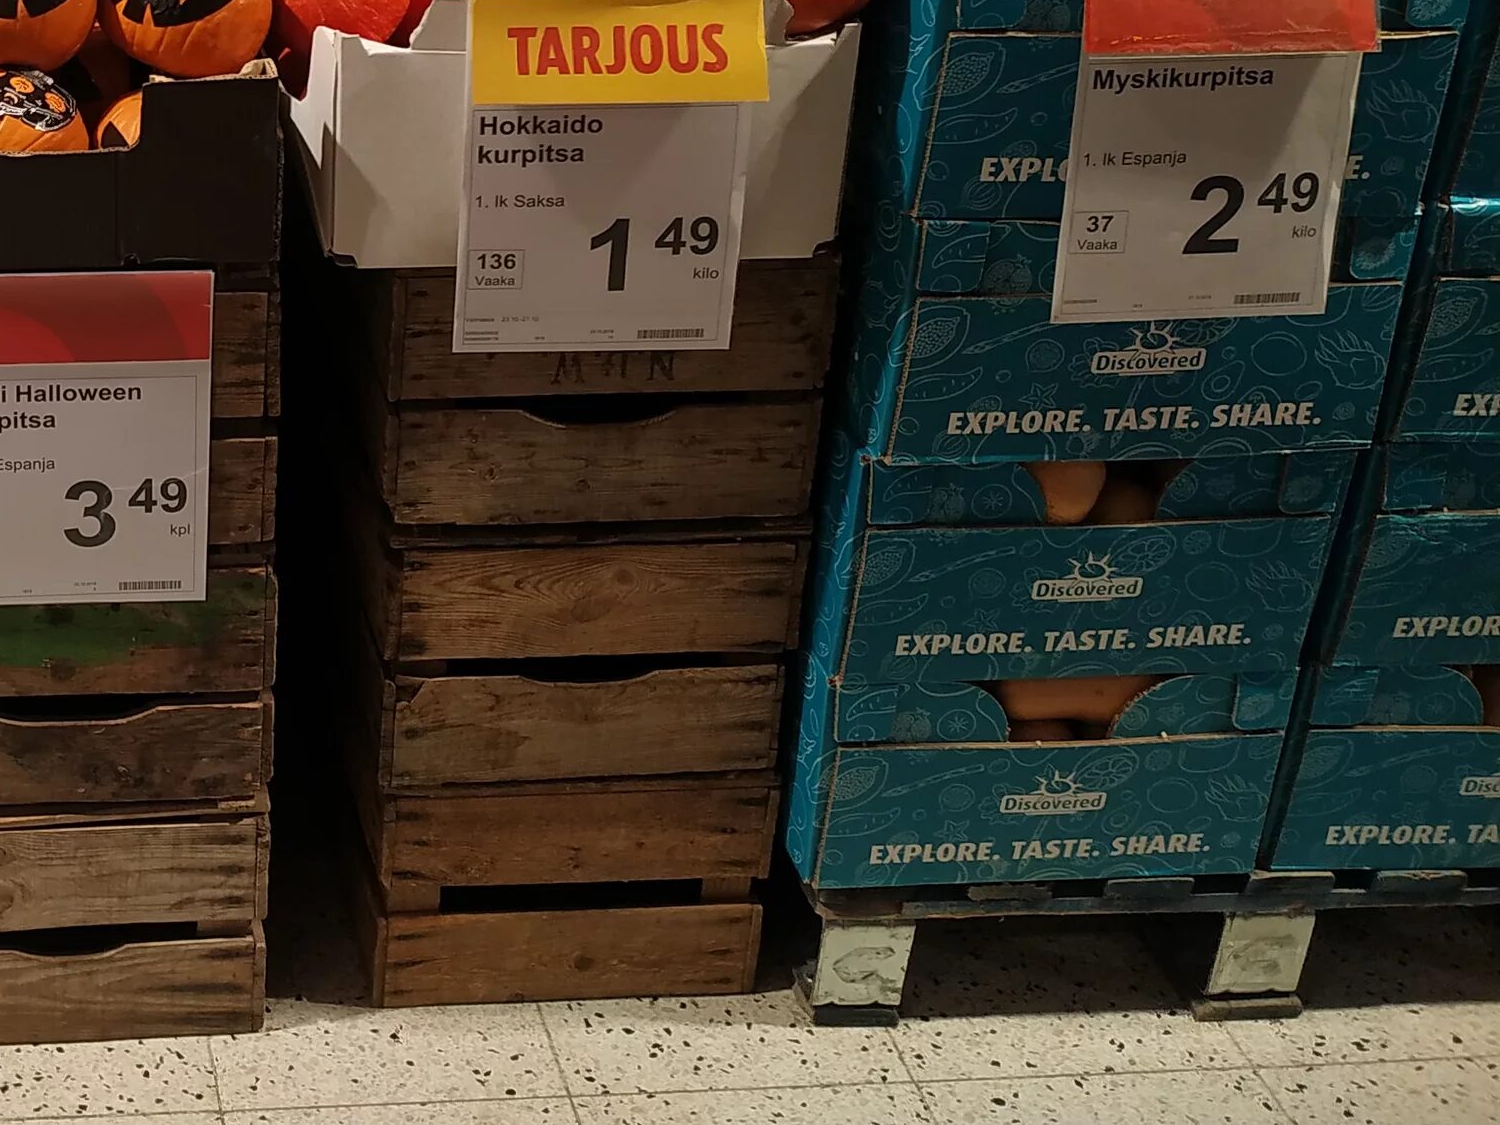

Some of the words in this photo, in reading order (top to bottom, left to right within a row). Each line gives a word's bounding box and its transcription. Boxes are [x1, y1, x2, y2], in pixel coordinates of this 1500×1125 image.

[507, 23, 729, 76] TARJOUS
[1092, 66, 1275, 95] Myskikurpitsa
[478, 115, 604, 136] Hokkaido
[477, 145, 585, 168] kurpitsa
[1083, 153, 1097, 167] 1.
[1122, 151, 1187, 170] Espanja
[475, 195, 489, 209] 1.
[514, 194, 566, 208] Saksa
[1086, 215, 1115, 233] 37
[1181, 175, 1245, 255] 2
[1257, 172, 1321, 214] 49
[1292, 225, 1317, 239] kilo
[589, 217, 631, 292] 1
[654, 216, 720, 256] 49
[1077, 239, 1118, 250] Vaaka
[477, 252, 517, 270] 136
[474, 275, 516, 286] Vaaka
[692, 266, 719, 279] kilo
[1095, 351, 1203, 372] Discovered
[15, 384, 142, 403] Halloween
[946, 409, 1092, 436] EXPLORE.
[1103, 405, 1200, 432] TASTE.
[1210, 401, 1322, 428] SHARE.
[63, 479, 117, 548] 3
[128, 477, 188, 514] 49
[170, 523, 191, 537] kpl
[1036, 580, 1140, 598] Discovered
[1392, 616, 1500, 638] EXPLOR
[894, 631, 1033, 657] EXPLORE.
[1044, 628, 1137, 653] TASTE.
[1146, 623, 1252, 648] SHARE.
[1004, 794, 1102, 812] Discovered
[1325, 825, 1457, 846] EXPLORE.
[869, 841, 1001, 865] EXPLORE.
[1011, 838, 1100, 861] TASTE.
[1109, 833, 1211, 857] SHARE.
